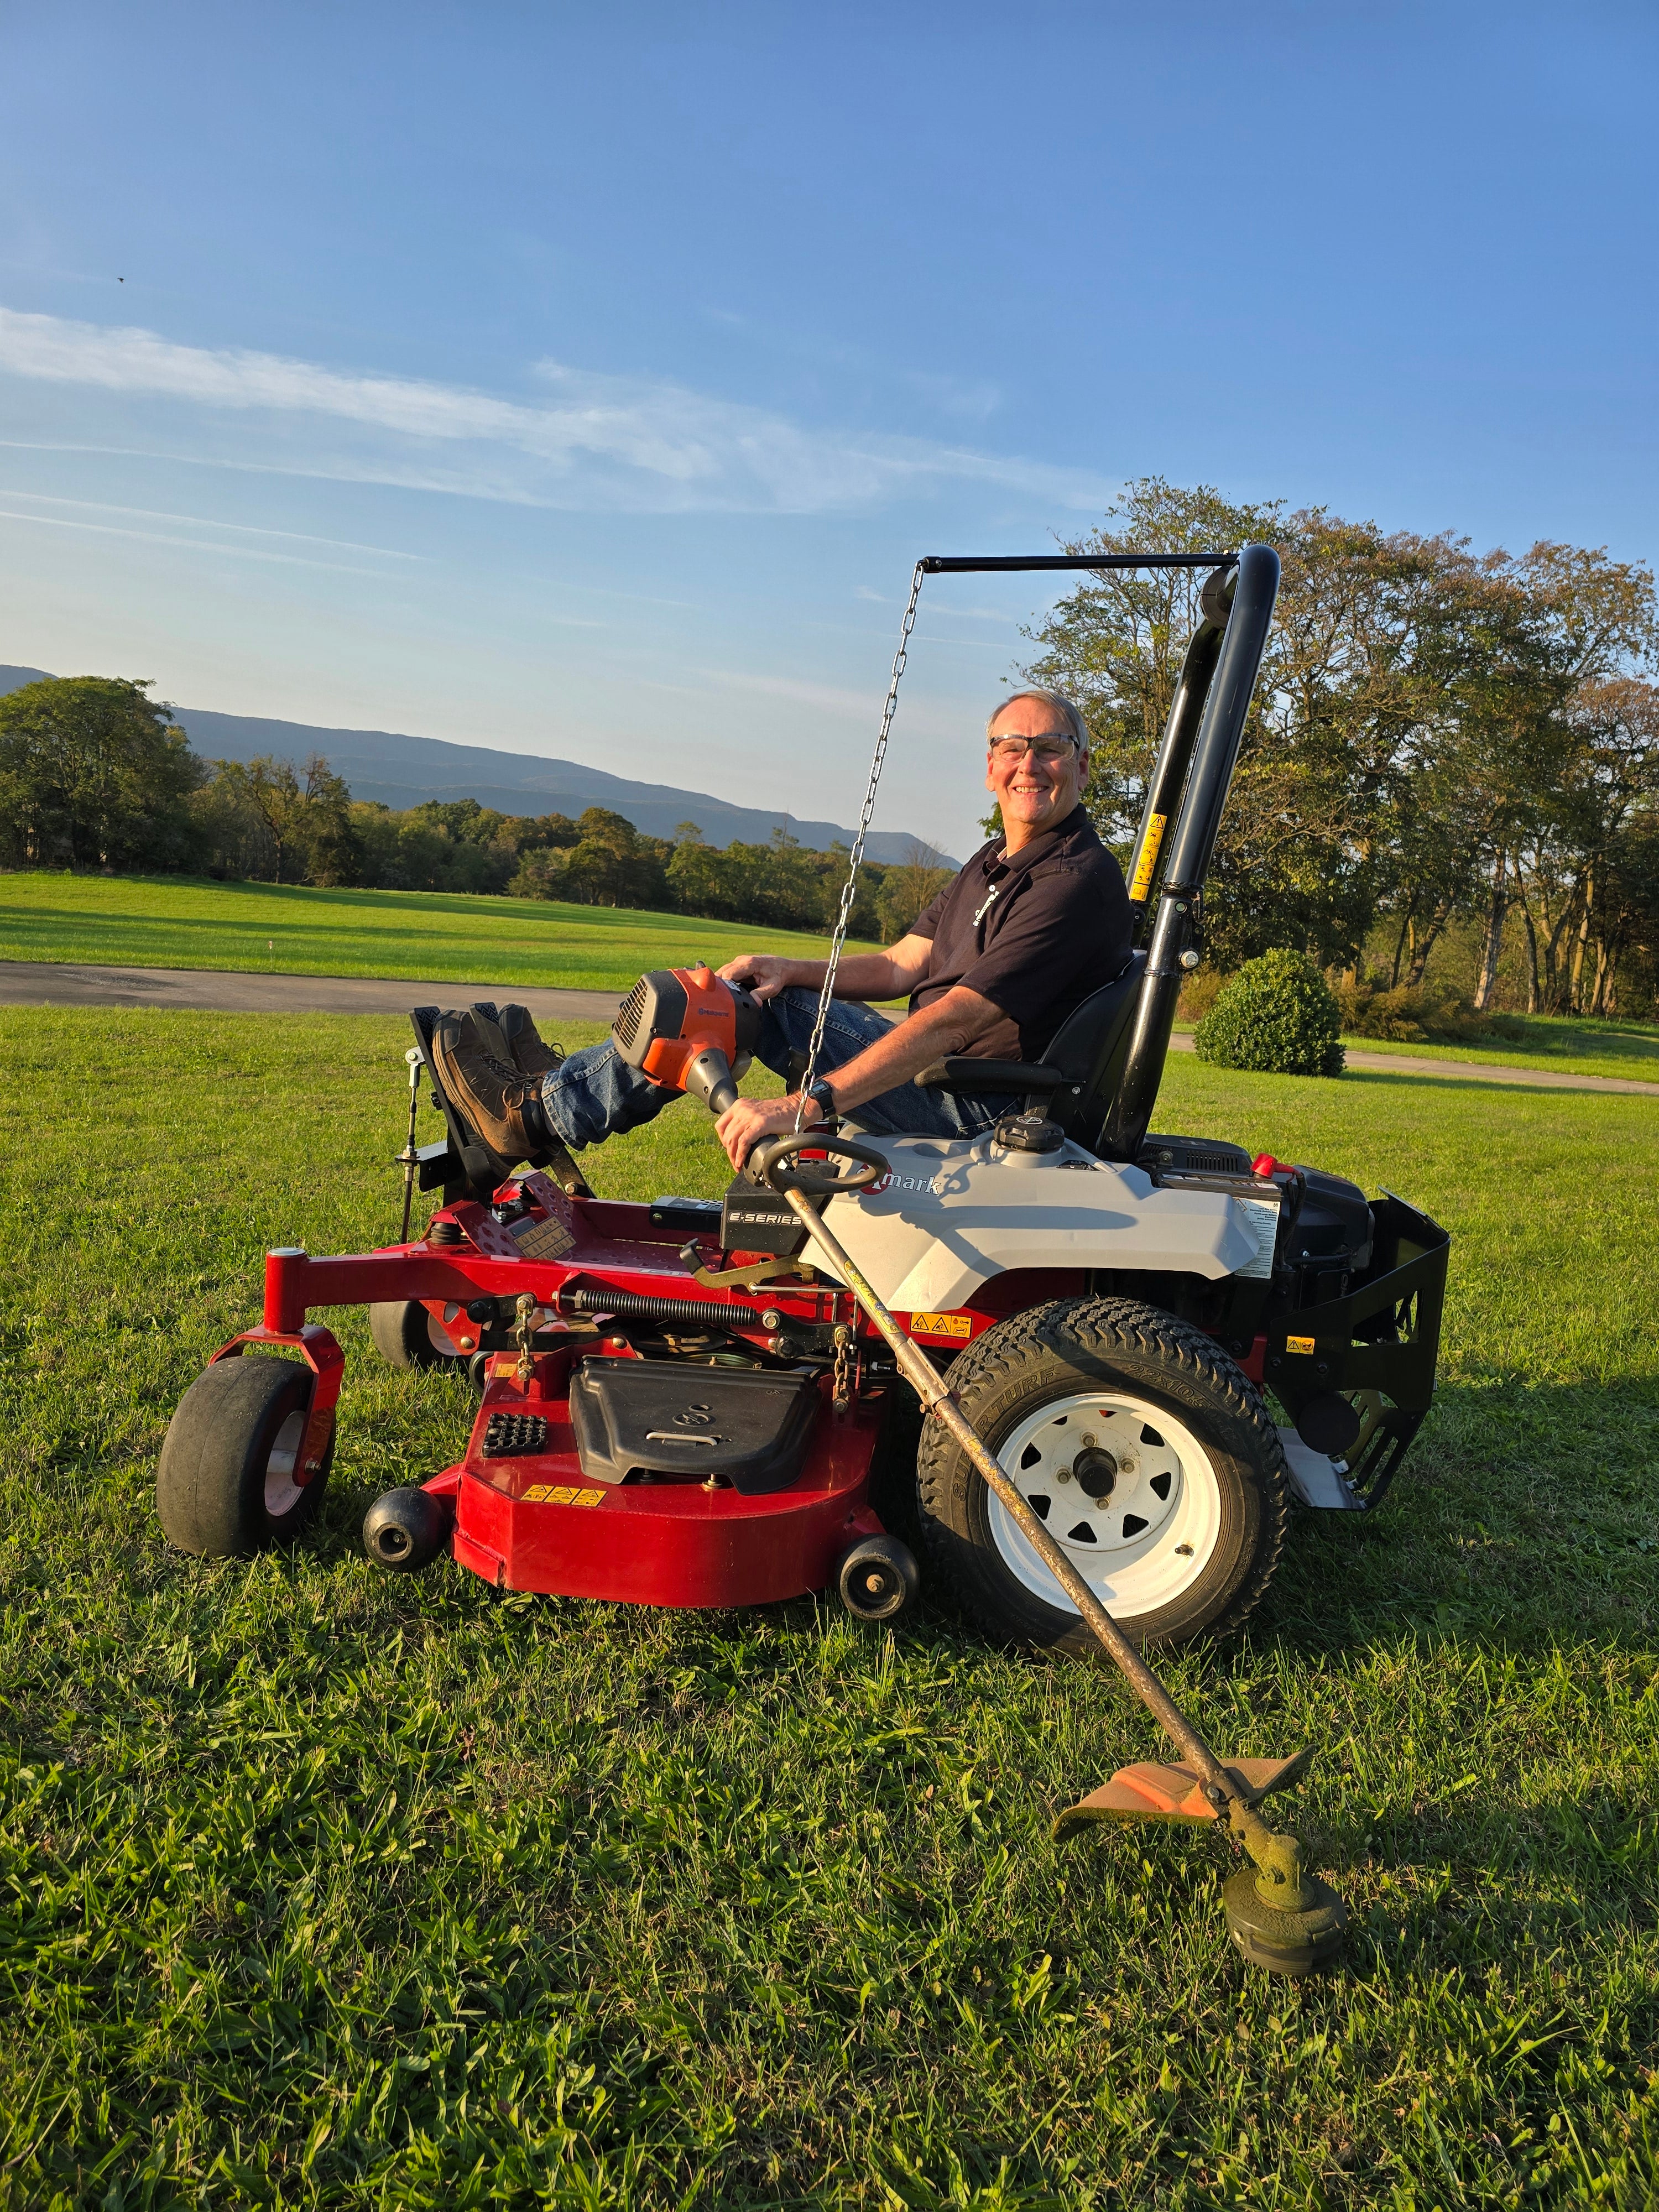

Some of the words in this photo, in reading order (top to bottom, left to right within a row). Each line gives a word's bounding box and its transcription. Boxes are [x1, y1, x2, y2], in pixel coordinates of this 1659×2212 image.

[856, 1165, 942, 1196] mark
[953, 1413, 993, 1502] SUPR
[990, 1366, 1055, 1415] TURF
